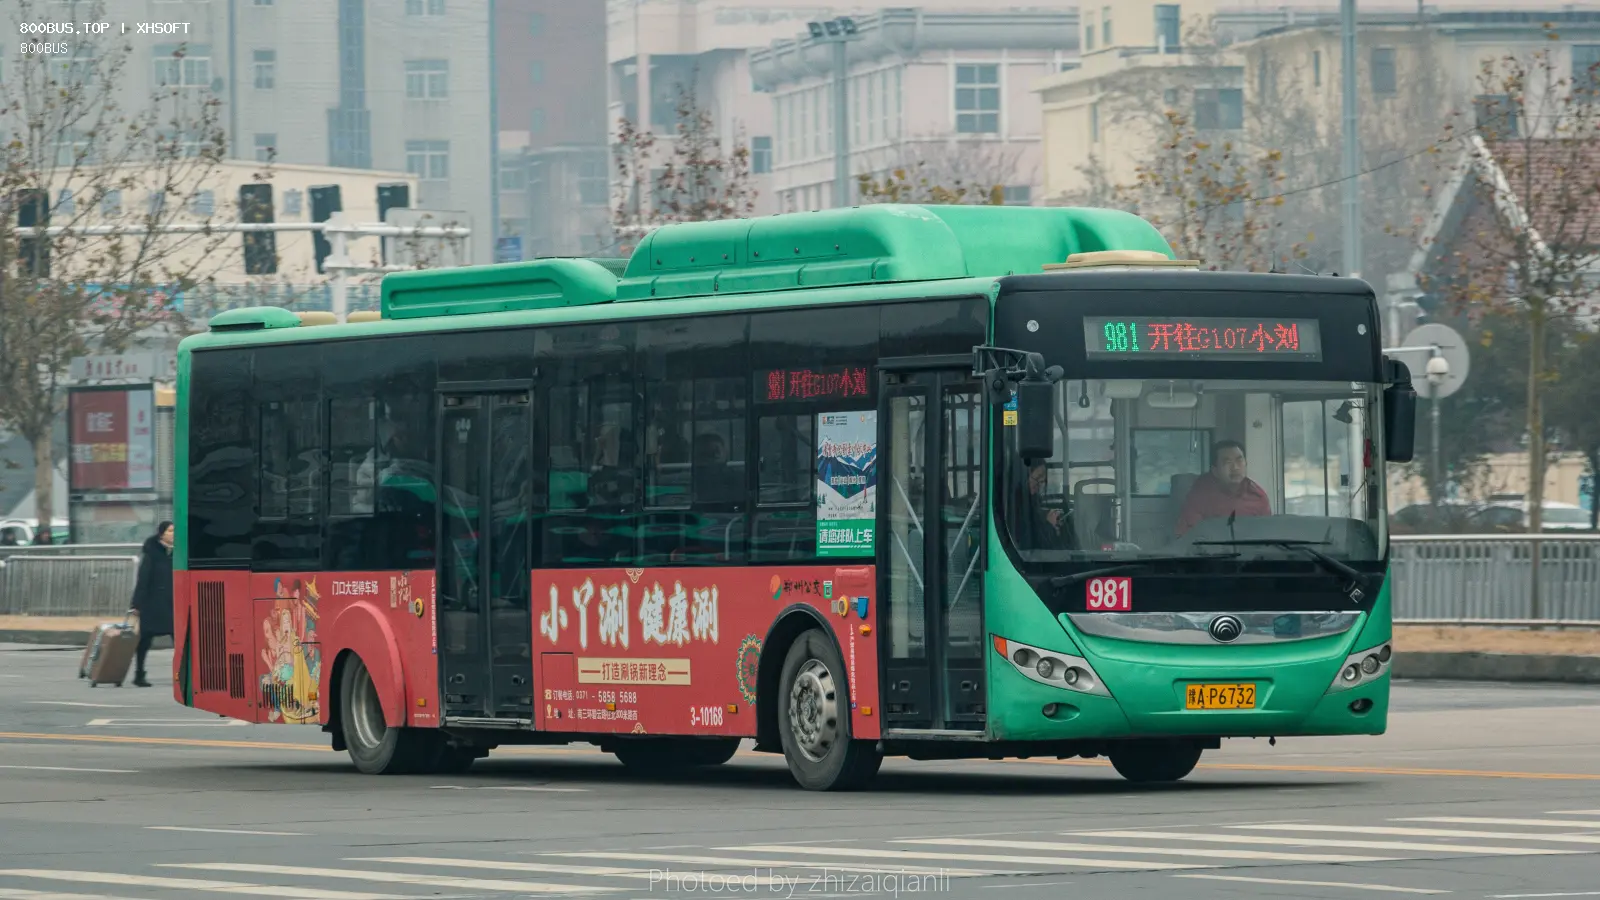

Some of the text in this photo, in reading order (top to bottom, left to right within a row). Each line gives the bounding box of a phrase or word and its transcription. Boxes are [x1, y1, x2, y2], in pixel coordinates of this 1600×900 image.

[1104, 322, 1299, 353] 981 开往G107小刘
[819, 528, 873, 544] 请您排队上车
[332, 580, 379, 596] 门口大型停车场
[1089, 579, 1129, 609] 981
[540, 577, 719, 650] 小丫涮 健康涮
[602, 662, 667, 682] 打造涮锅新理念
[598, 690, 616, 703] 5858
[619, 691, 637, 703] 5688
[690, 706, 723, 726] 3-10168
